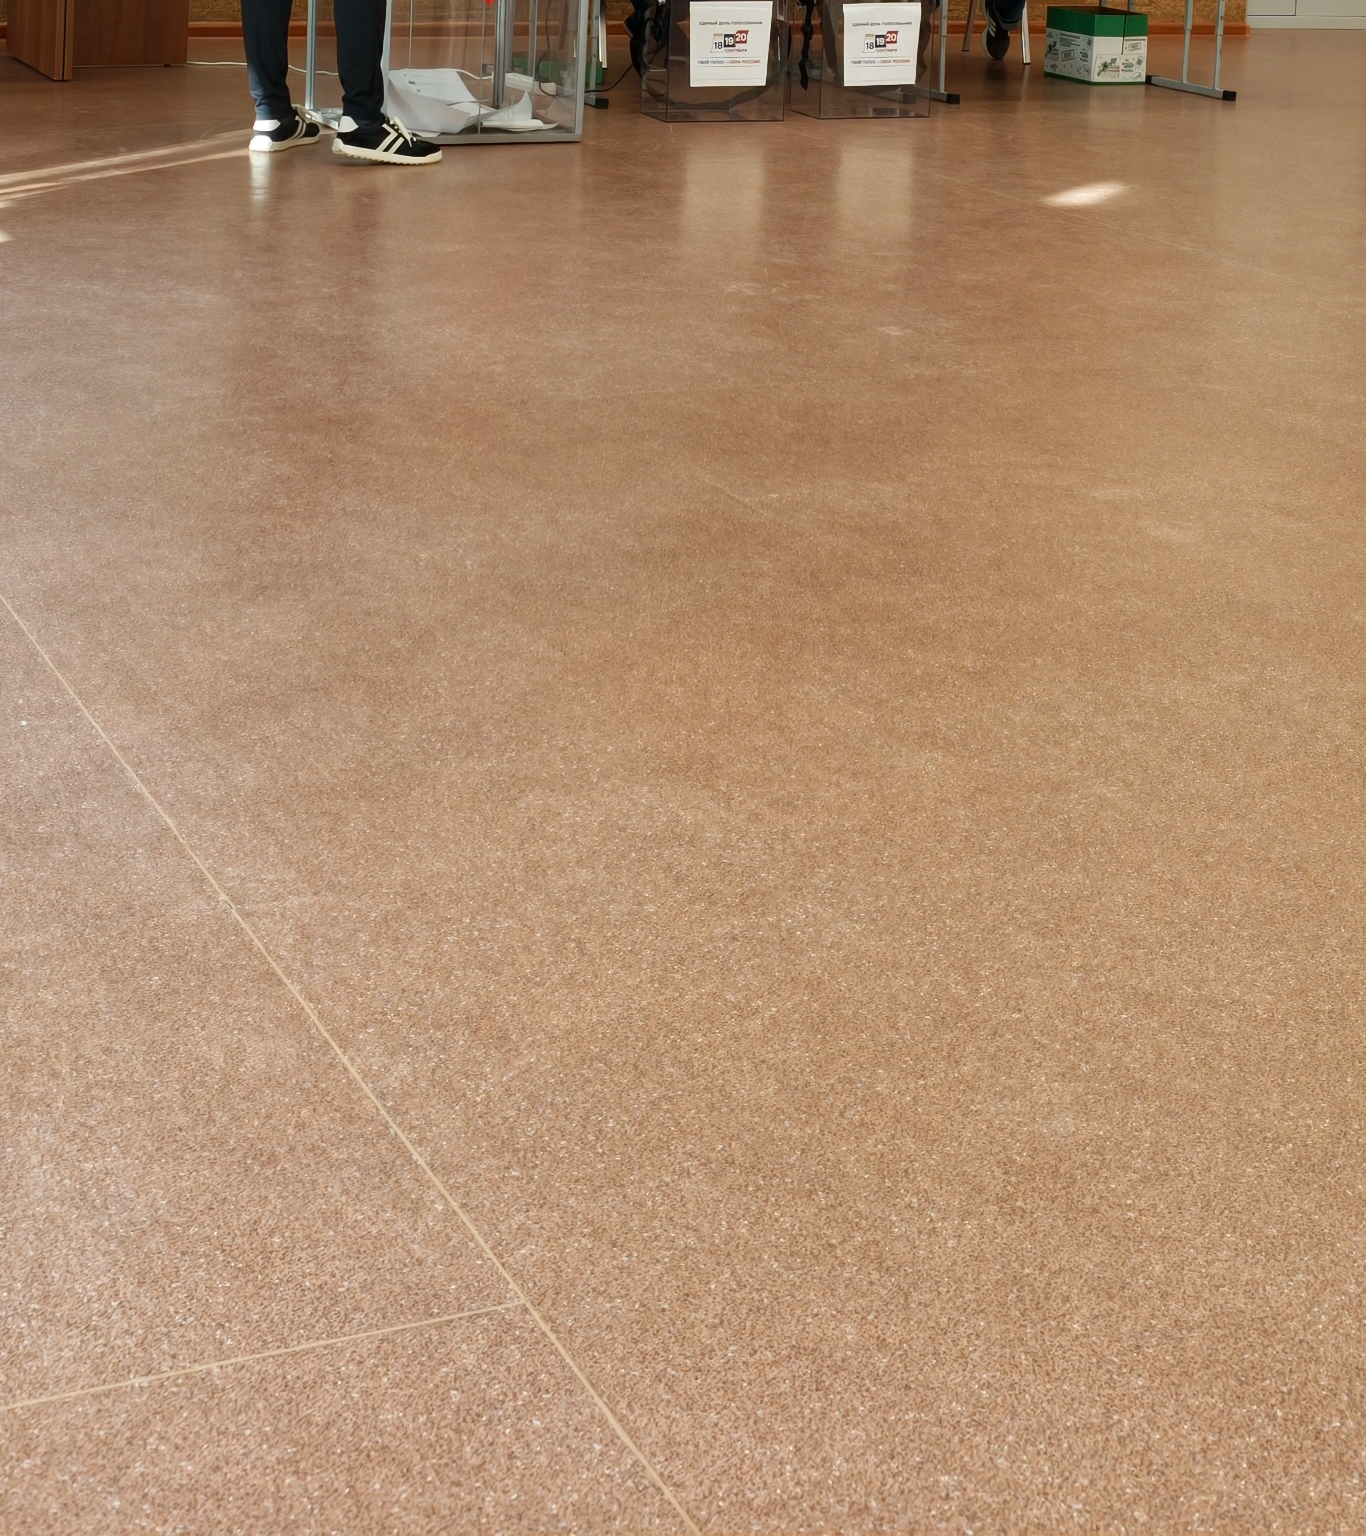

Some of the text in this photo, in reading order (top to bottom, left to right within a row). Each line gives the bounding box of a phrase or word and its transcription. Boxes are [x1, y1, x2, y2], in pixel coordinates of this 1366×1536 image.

[724, 36, 734, 46] 19
[735, 32, 747, 42] 20
[876, 37, 885, 46] 19
[886, 33, 897, 42] 20
[714, 41, 723, 50] 18
[866, 42, 874, 50] 18
